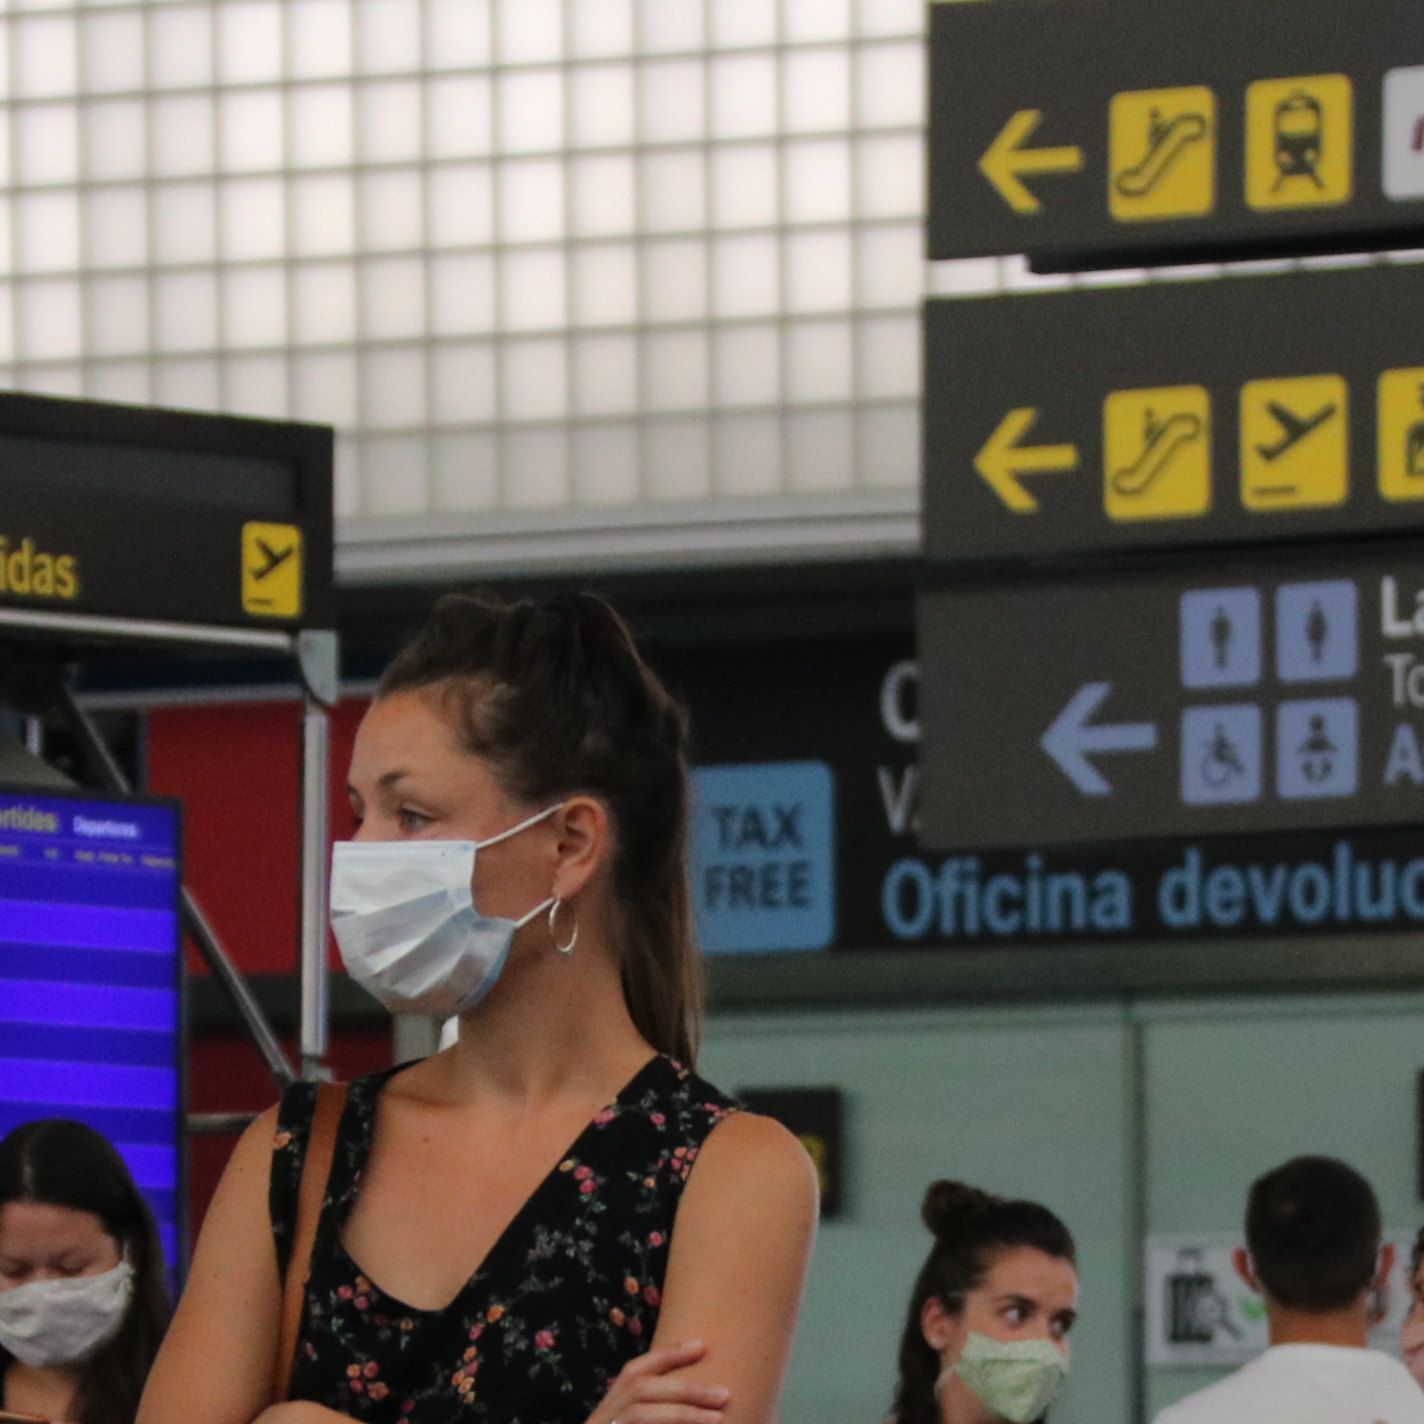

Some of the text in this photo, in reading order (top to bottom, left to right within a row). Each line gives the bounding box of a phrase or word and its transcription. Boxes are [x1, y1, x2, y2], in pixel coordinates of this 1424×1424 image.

[710, 804, 802, 852] TAX
[704, 859, 812, 909] FREE
[882, 851, 1133, 941] Oficina
